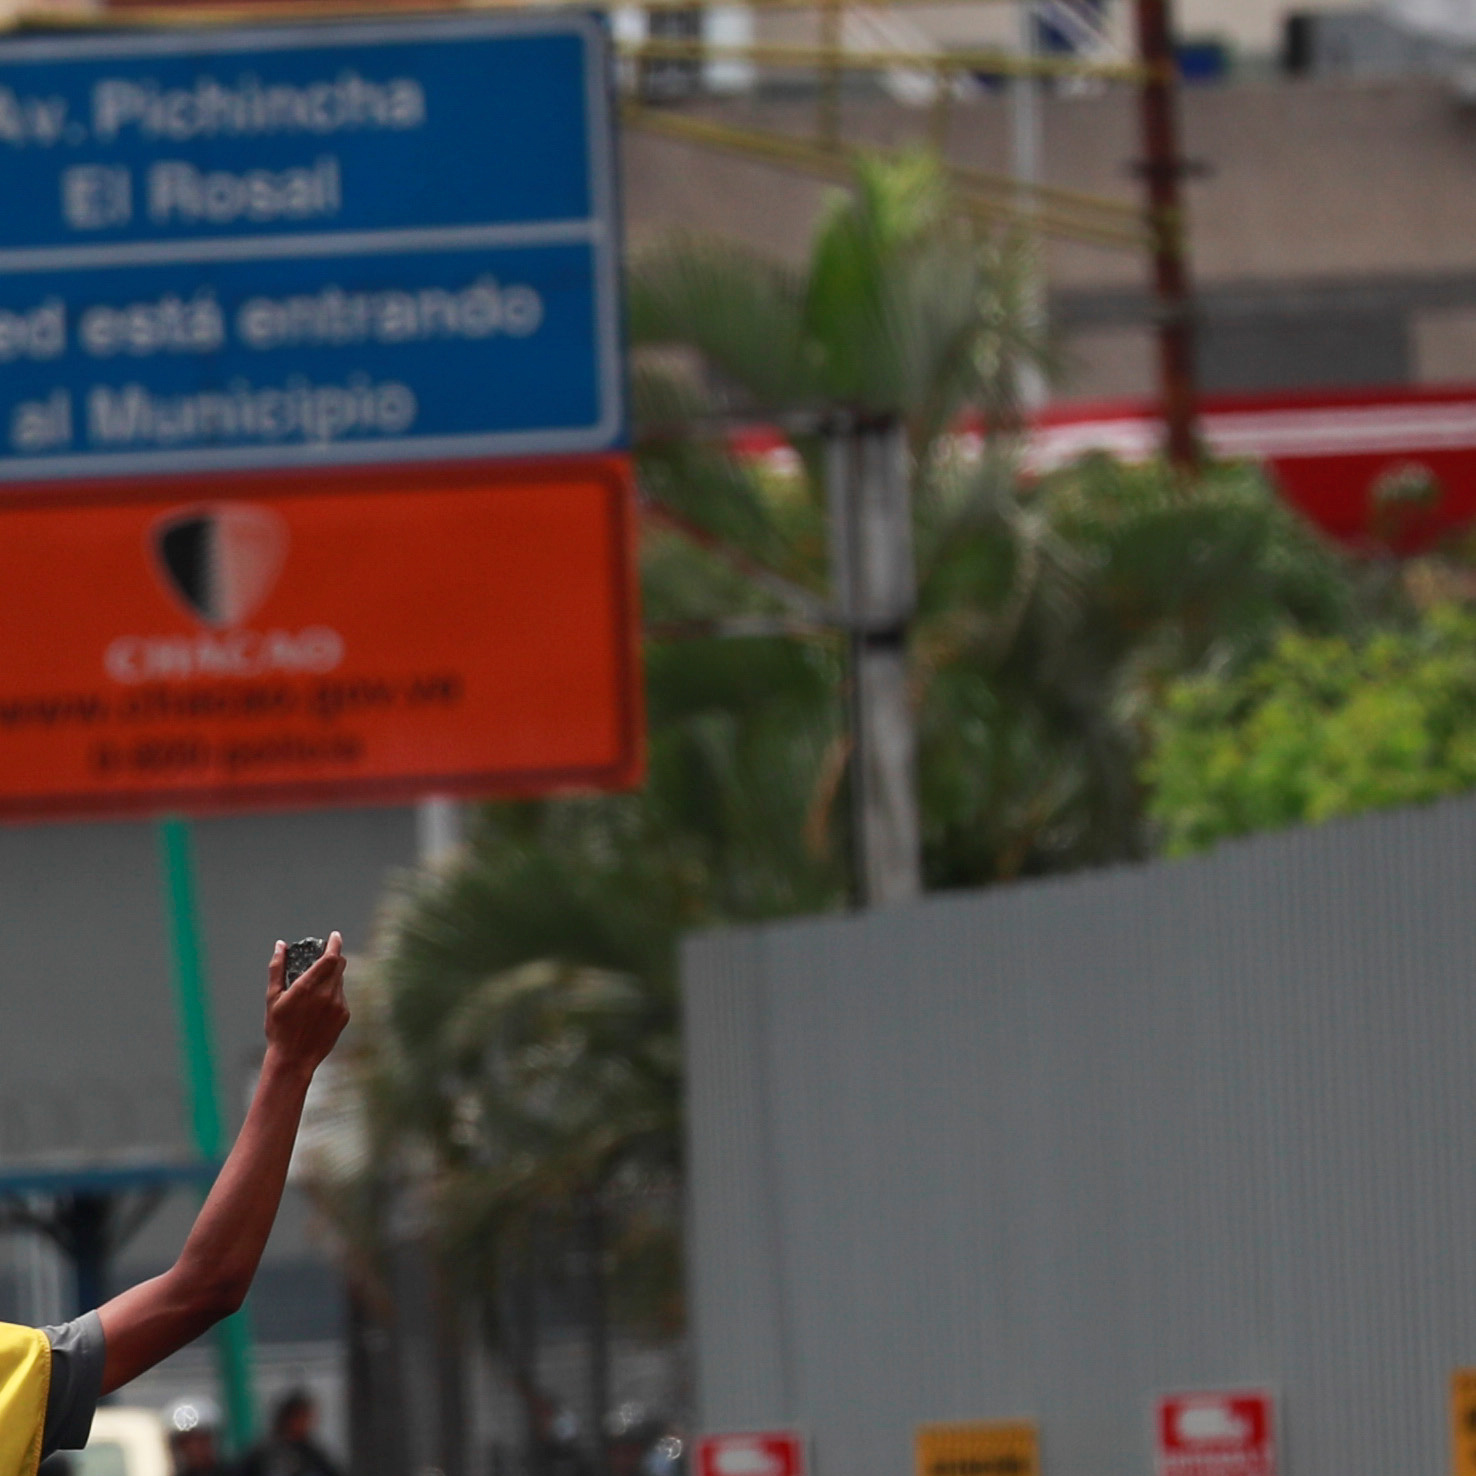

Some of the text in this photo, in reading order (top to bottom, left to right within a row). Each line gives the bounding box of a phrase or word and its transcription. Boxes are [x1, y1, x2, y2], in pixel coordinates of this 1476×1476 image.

[92, 70, 426, 141] Pichincha
[63, 155, 341, 229] El Rosal
[79, 288, 224, 356] está
[238, 275, 543, 345] entrando
[11, 374, 418, 452] al Municipio
[104, 626, 344, 684] CHACAO
